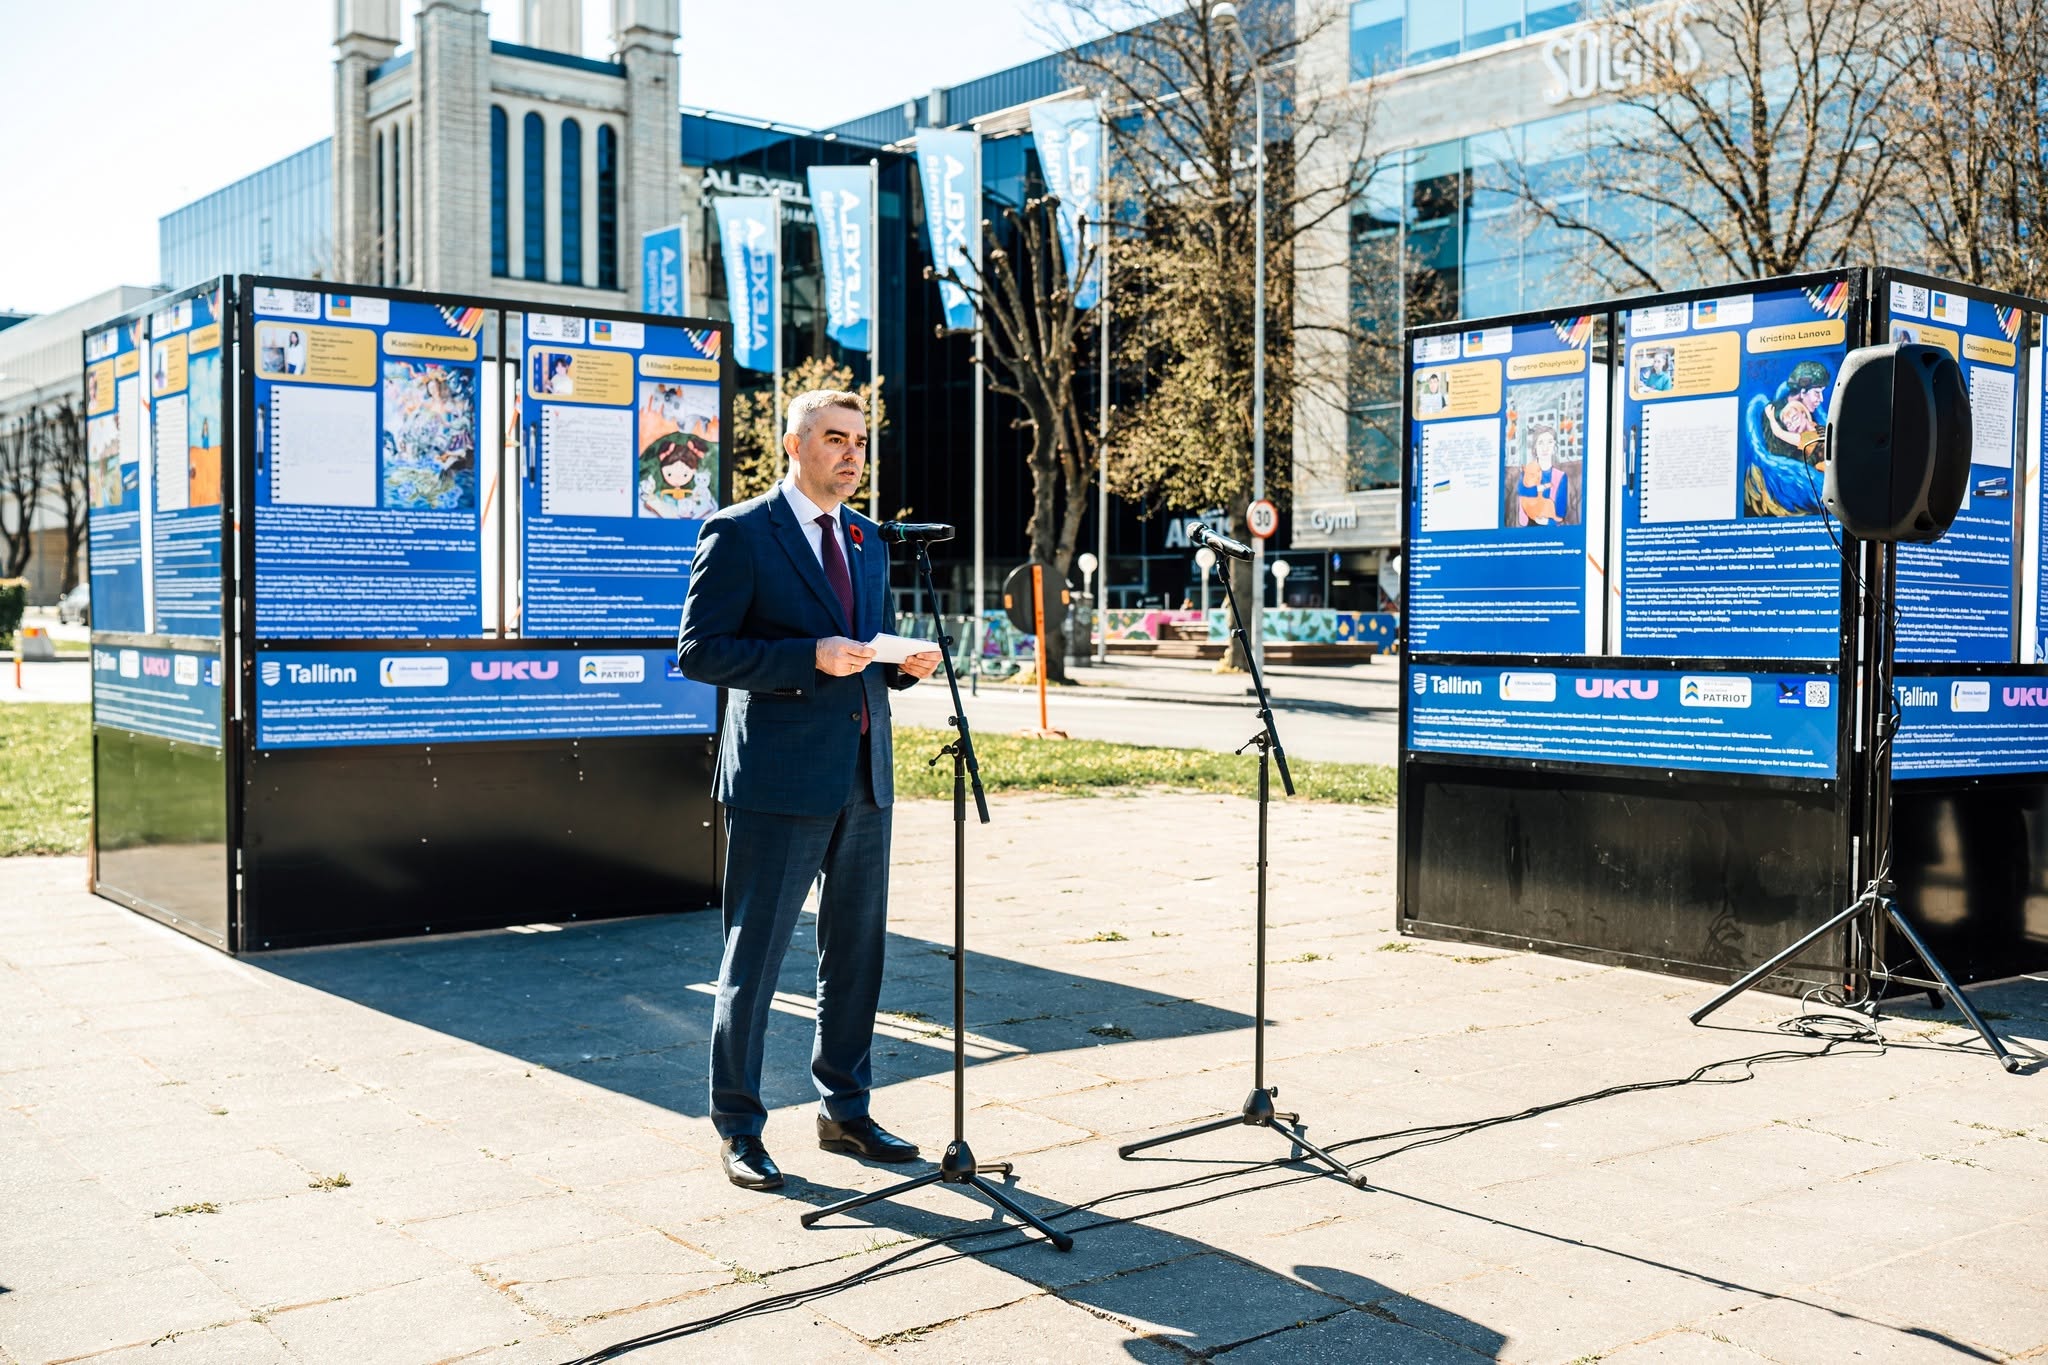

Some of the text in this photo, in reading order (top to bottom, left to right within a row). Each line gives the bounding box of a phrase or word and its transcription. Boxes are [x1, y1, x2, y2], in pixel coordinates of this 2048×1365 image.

[1759, 330, 1831, 344] Kristina Lanova
[1255, 511, 1271, 527] 30
[286, 664, 357, 684] Tallinn
[471, 661, 559, 680] UKU
[601, 671, 640, 679] PATRIOT
[1430, 676, 1482, 695] Tallinn
[1575, 678, 1659, 699] UKU
[1703, 693, 1747, 703] PATRIOT
[1898, 686, 1938, 707] Tallinn
